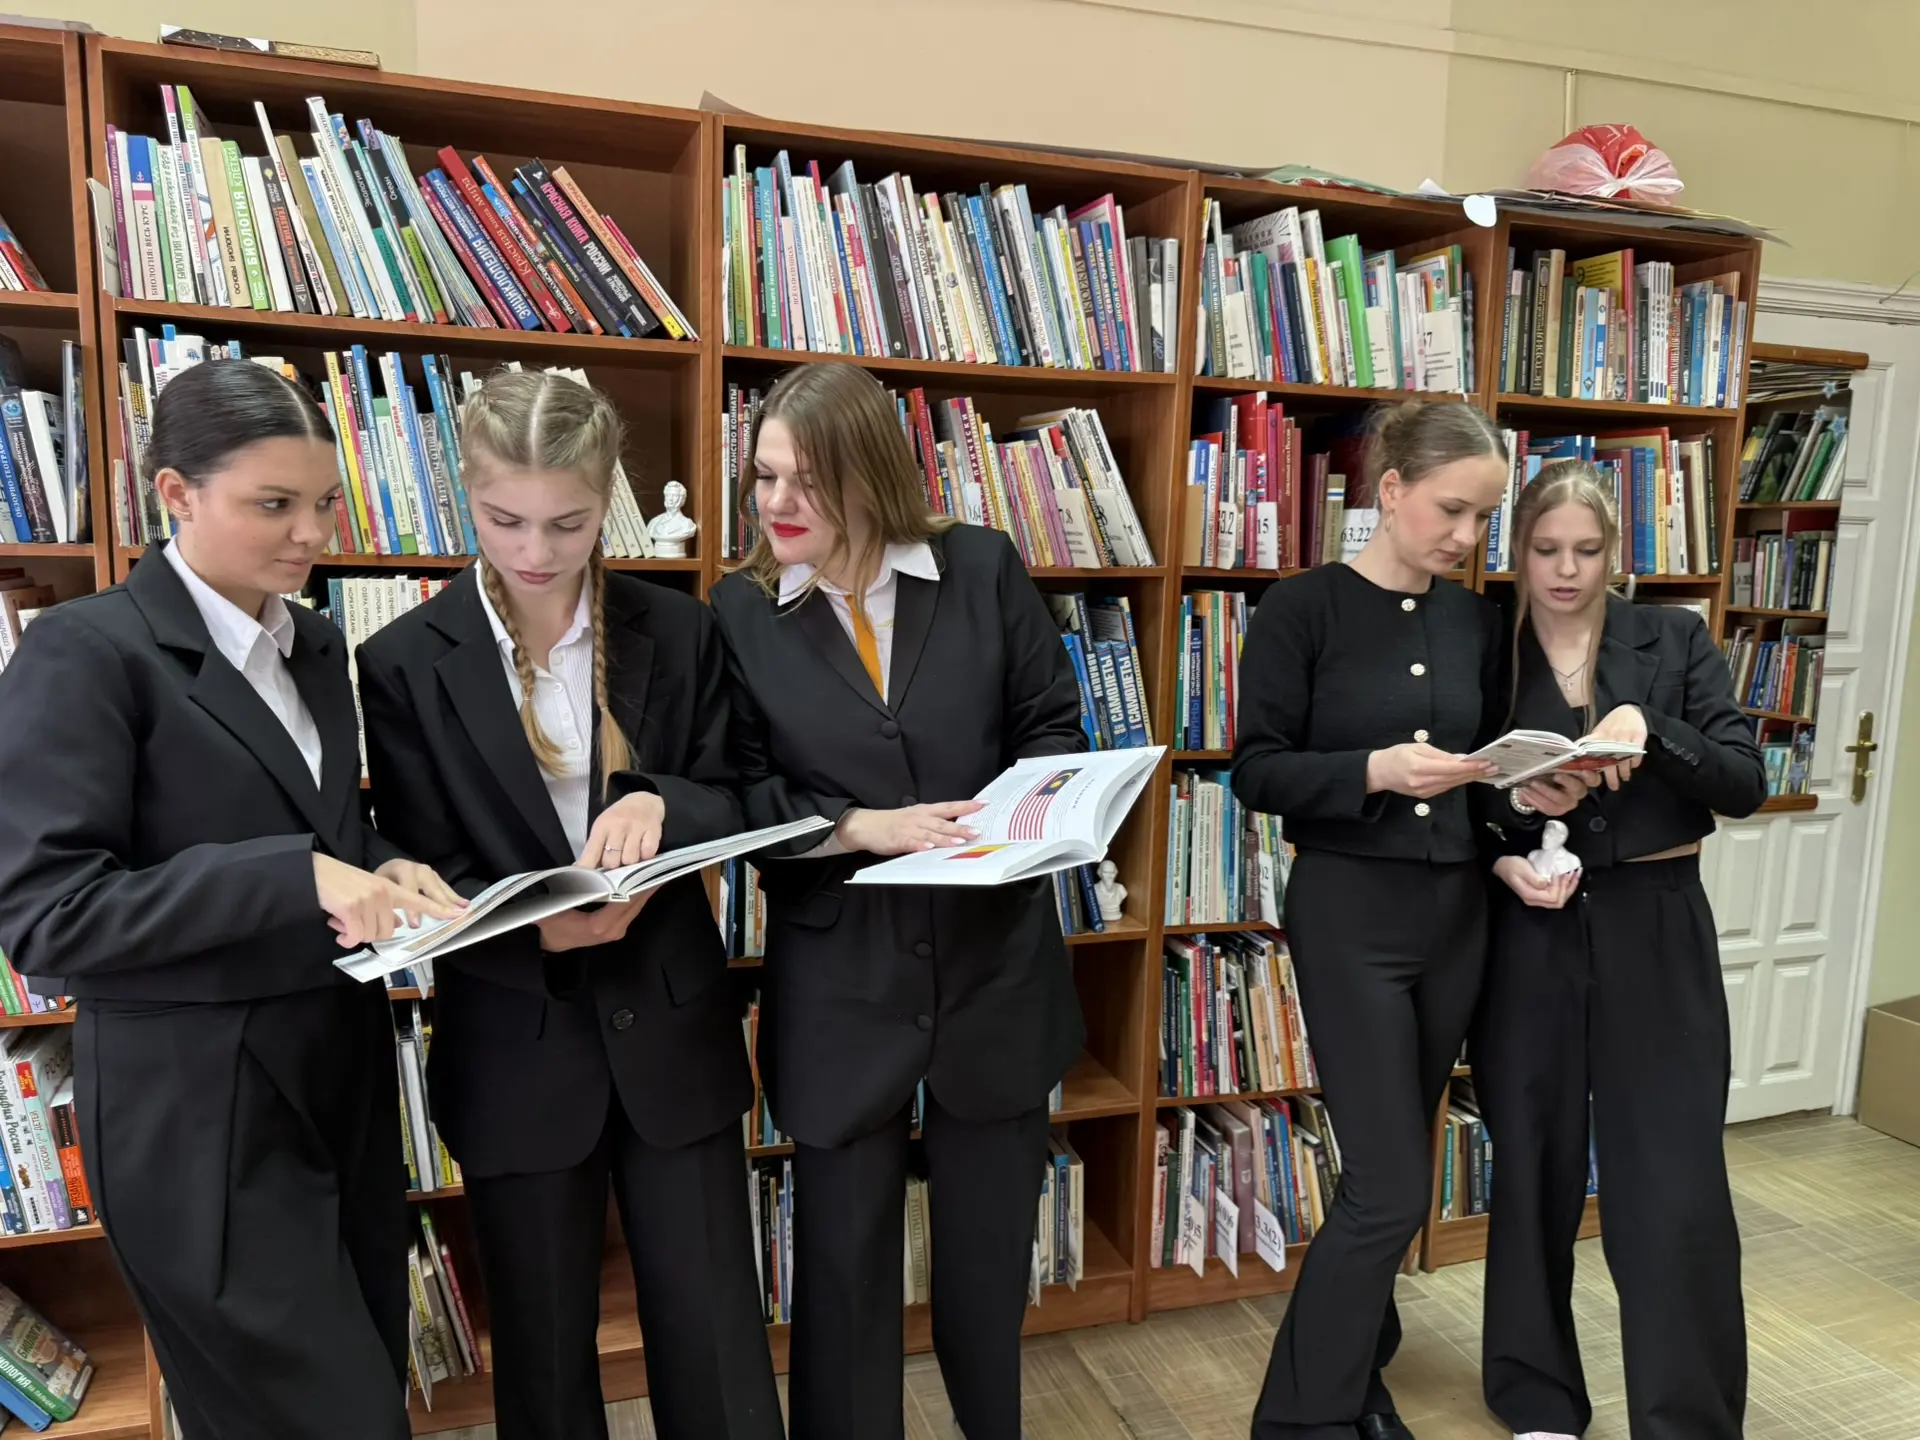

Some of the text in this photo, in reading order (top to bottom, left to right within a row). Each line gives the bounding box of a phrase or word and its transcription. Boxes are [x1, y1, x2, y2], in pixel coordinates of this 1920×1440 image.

[225, 145, 257, 266] БИОЛОГИЯ КЛЕТКИ
[353, 169, 372, 207] Экология
[383, 174, 398, 200] Океан
[763, 187, 772, 232] ПОДЕЛОК
[140, 204, 149, 225] КУРС
[143, 226, 151, 246] ВЕСЬ
[276, 206, 293, 246] ГЕНЕТИКА
[460, 174, 532, 276] Красная книга мира
[539, 180, 612, 275] КРАСНАЯ КНИГА РОССИИ
[565, 181, 629, 265] КРАСНАЯ КНИГА РОССИИ
[172, 239, 185, 279] БИОЛОГИЯ
[223, 225, 240, 294] ОСНОВЫ БИОЛОГИИ
[502, 213, 540, 263] НАЦИОНАЛЬНЫЙ
[915, 230, 930, 275] МАКРАМЕ
[467, 236, 535, 320] ЭНЦИКЛОПЕДИЯ
[535, 262, 575, 315] ПРИБАЙКАЛЬСКИЙ
[1031, 306, 1048, 346] КРЮЧКОМ
[1533, 331, 1544, 385] ИСТОРИЯ
[961, 412, 980, 476] ПРИЧЕСКИ
[1488, 506, 1500, 548] ИСТОРИ
[1085, 652, 1103, 698] АВИАЦИИ
[1097, 654, 1124, 722] САМОЛЕТЫ
[1115, 655, 1142, 723] САМОЛЕТЫ
[6, 1119, 23, 1155] России
[29, 1110, 42, 1132] ДЕТЕЙ
[38, 1144, 52, 1171] РОССИЯ
[66, 1176, 81, 1208] РЯЗАНЬ
